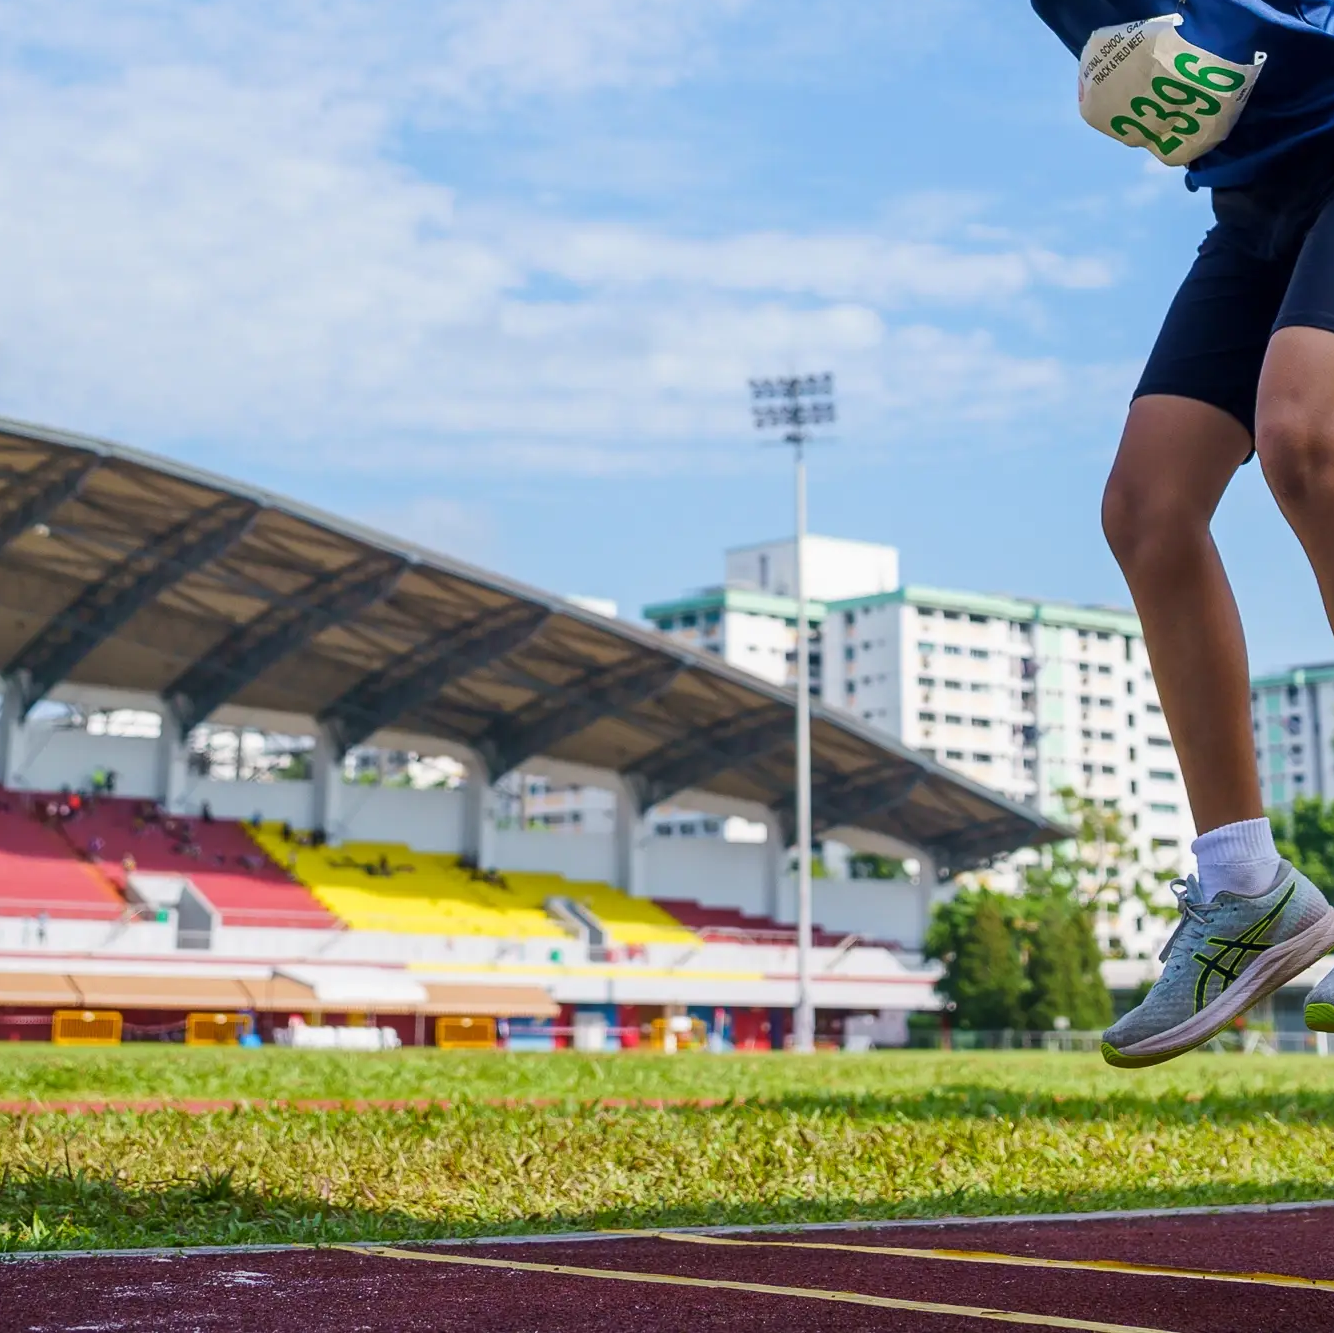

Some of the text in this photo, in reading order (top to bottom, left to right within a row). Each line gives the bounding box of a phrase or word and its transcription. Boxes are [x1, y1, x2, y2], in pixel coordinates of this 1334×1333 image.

[1092, 30, 1146, 85] TRACK & FIELD MEET
[1100, 32, 1125, 57] SCHOOL
[1110, 53, 1245, 155] 2396
